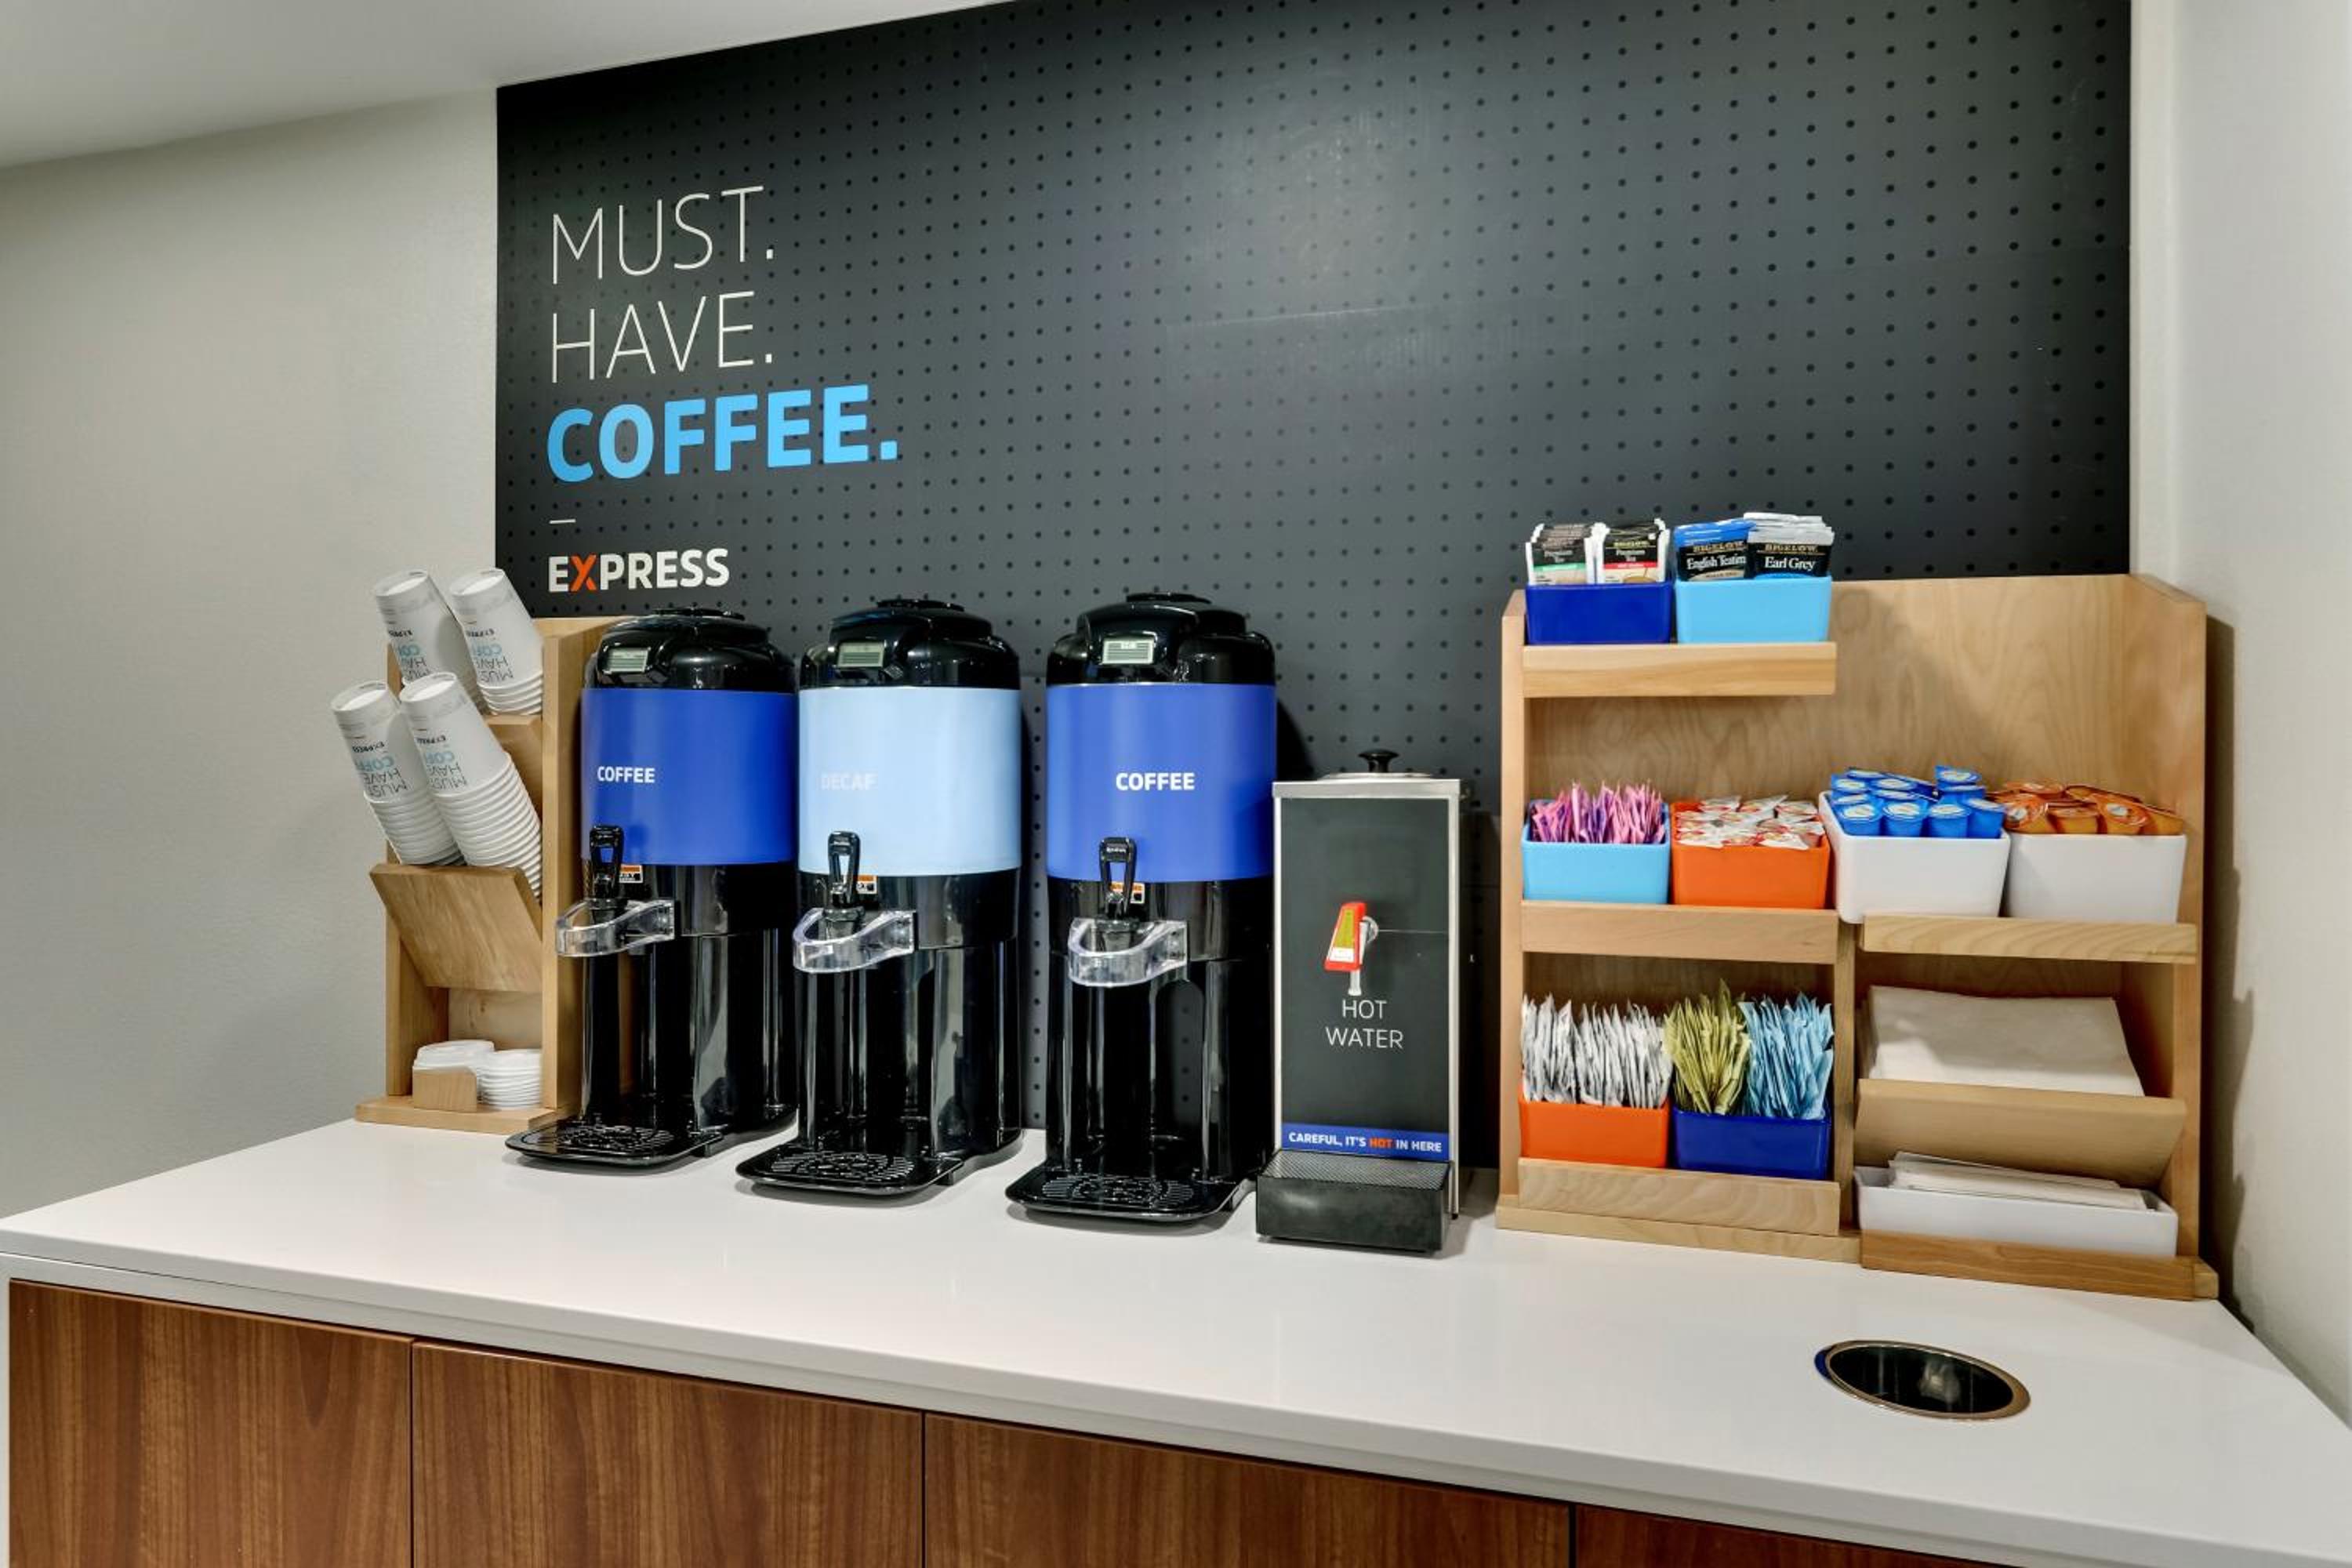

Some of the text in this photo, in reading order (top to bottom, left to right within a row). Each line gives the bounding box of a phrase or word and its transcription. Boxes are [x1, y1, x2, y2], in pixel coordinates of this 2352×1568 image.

[552, 185, 774, 285] MUST.
[552, 291, 773, 383] HAVE.
[547, 384, 898, 483] COFFEE.
[1719, 553, 1747, 566] Teatim
[1764, 557, 1816, 572] Earl Grey
[548, 548, 730, 593] EXPRESS
[597, 765, 655, 783] COFFEE
[820, 773, 878, 790] DECAF
[1116, 772, 1196, 791] COFFEE
[1341, 1000, 1388, 1019] HOT
[1325, 1027, 1404, 1049] WATER
[1288, 1132, 1443, 1152] CAREFUL, IT'S HOT IN HERE
